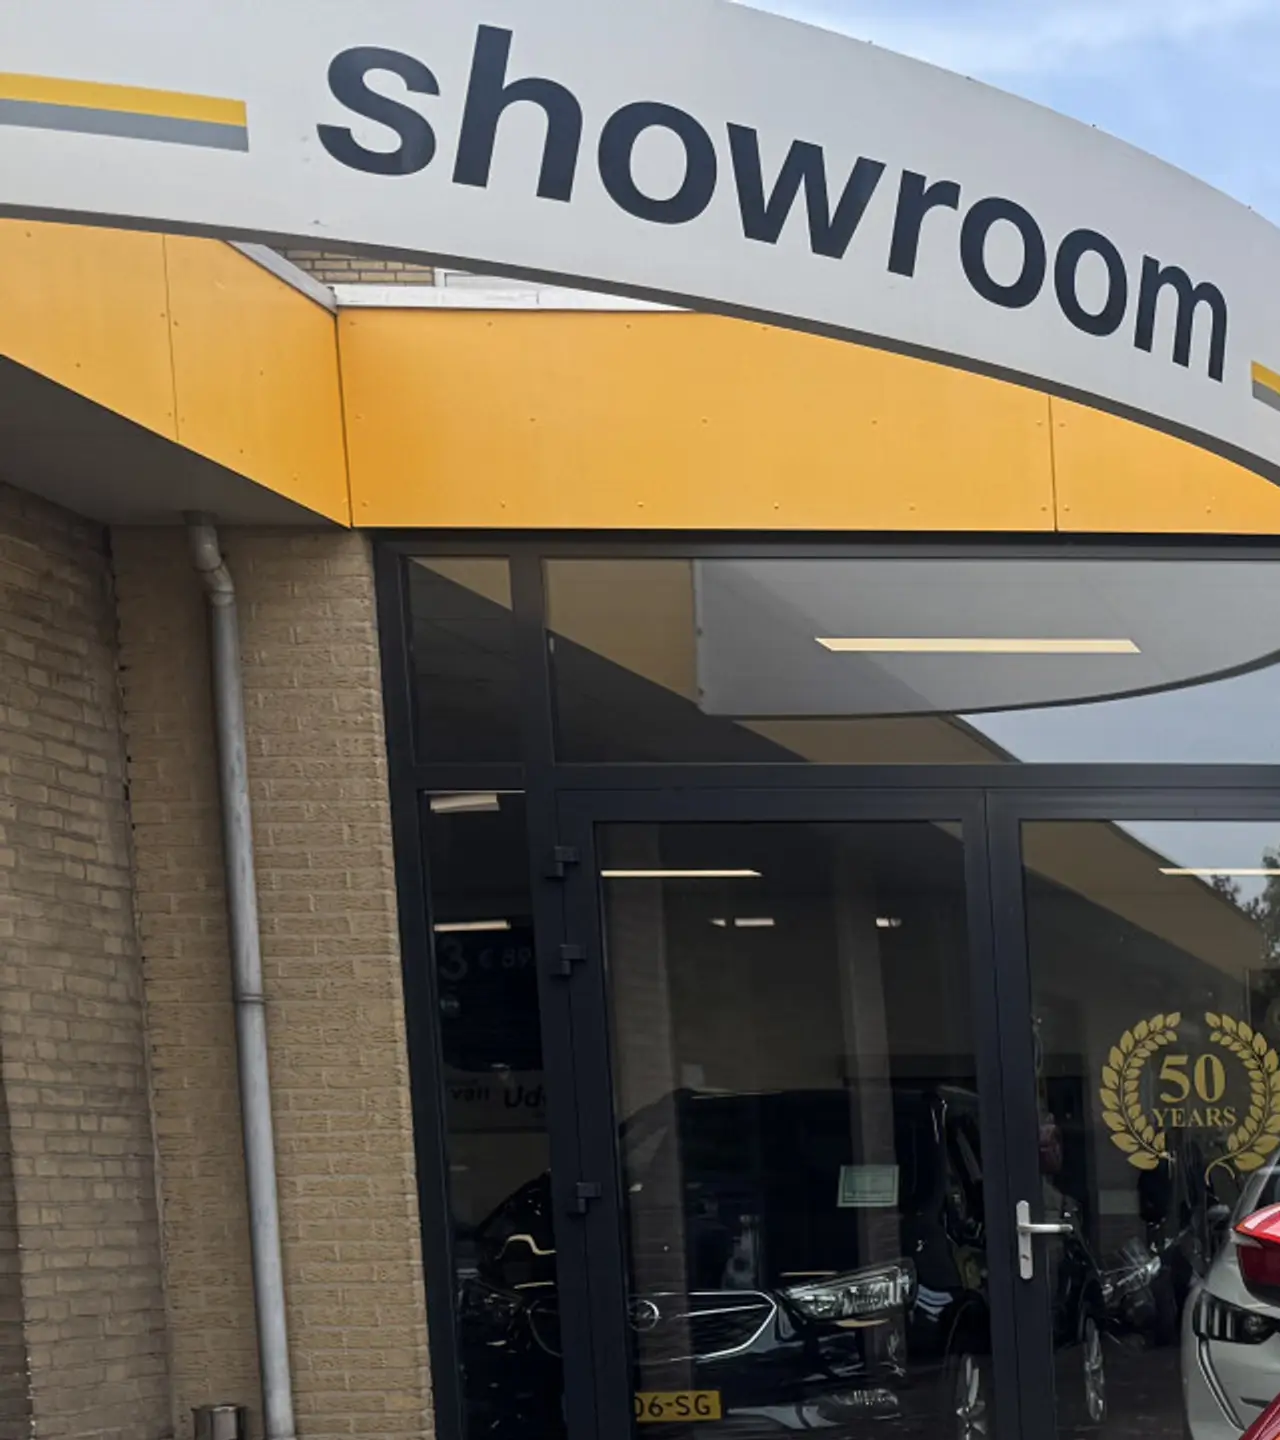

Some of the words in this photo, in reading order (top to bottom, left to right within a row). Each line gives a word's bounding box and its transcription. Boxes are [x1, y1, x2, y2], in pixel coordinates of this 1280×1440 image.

[316, 25, 1231, 383] showroom
[1158, 1053, 1227, 1104] 50
[1151, 1106, 1238, 1129] YEARS
